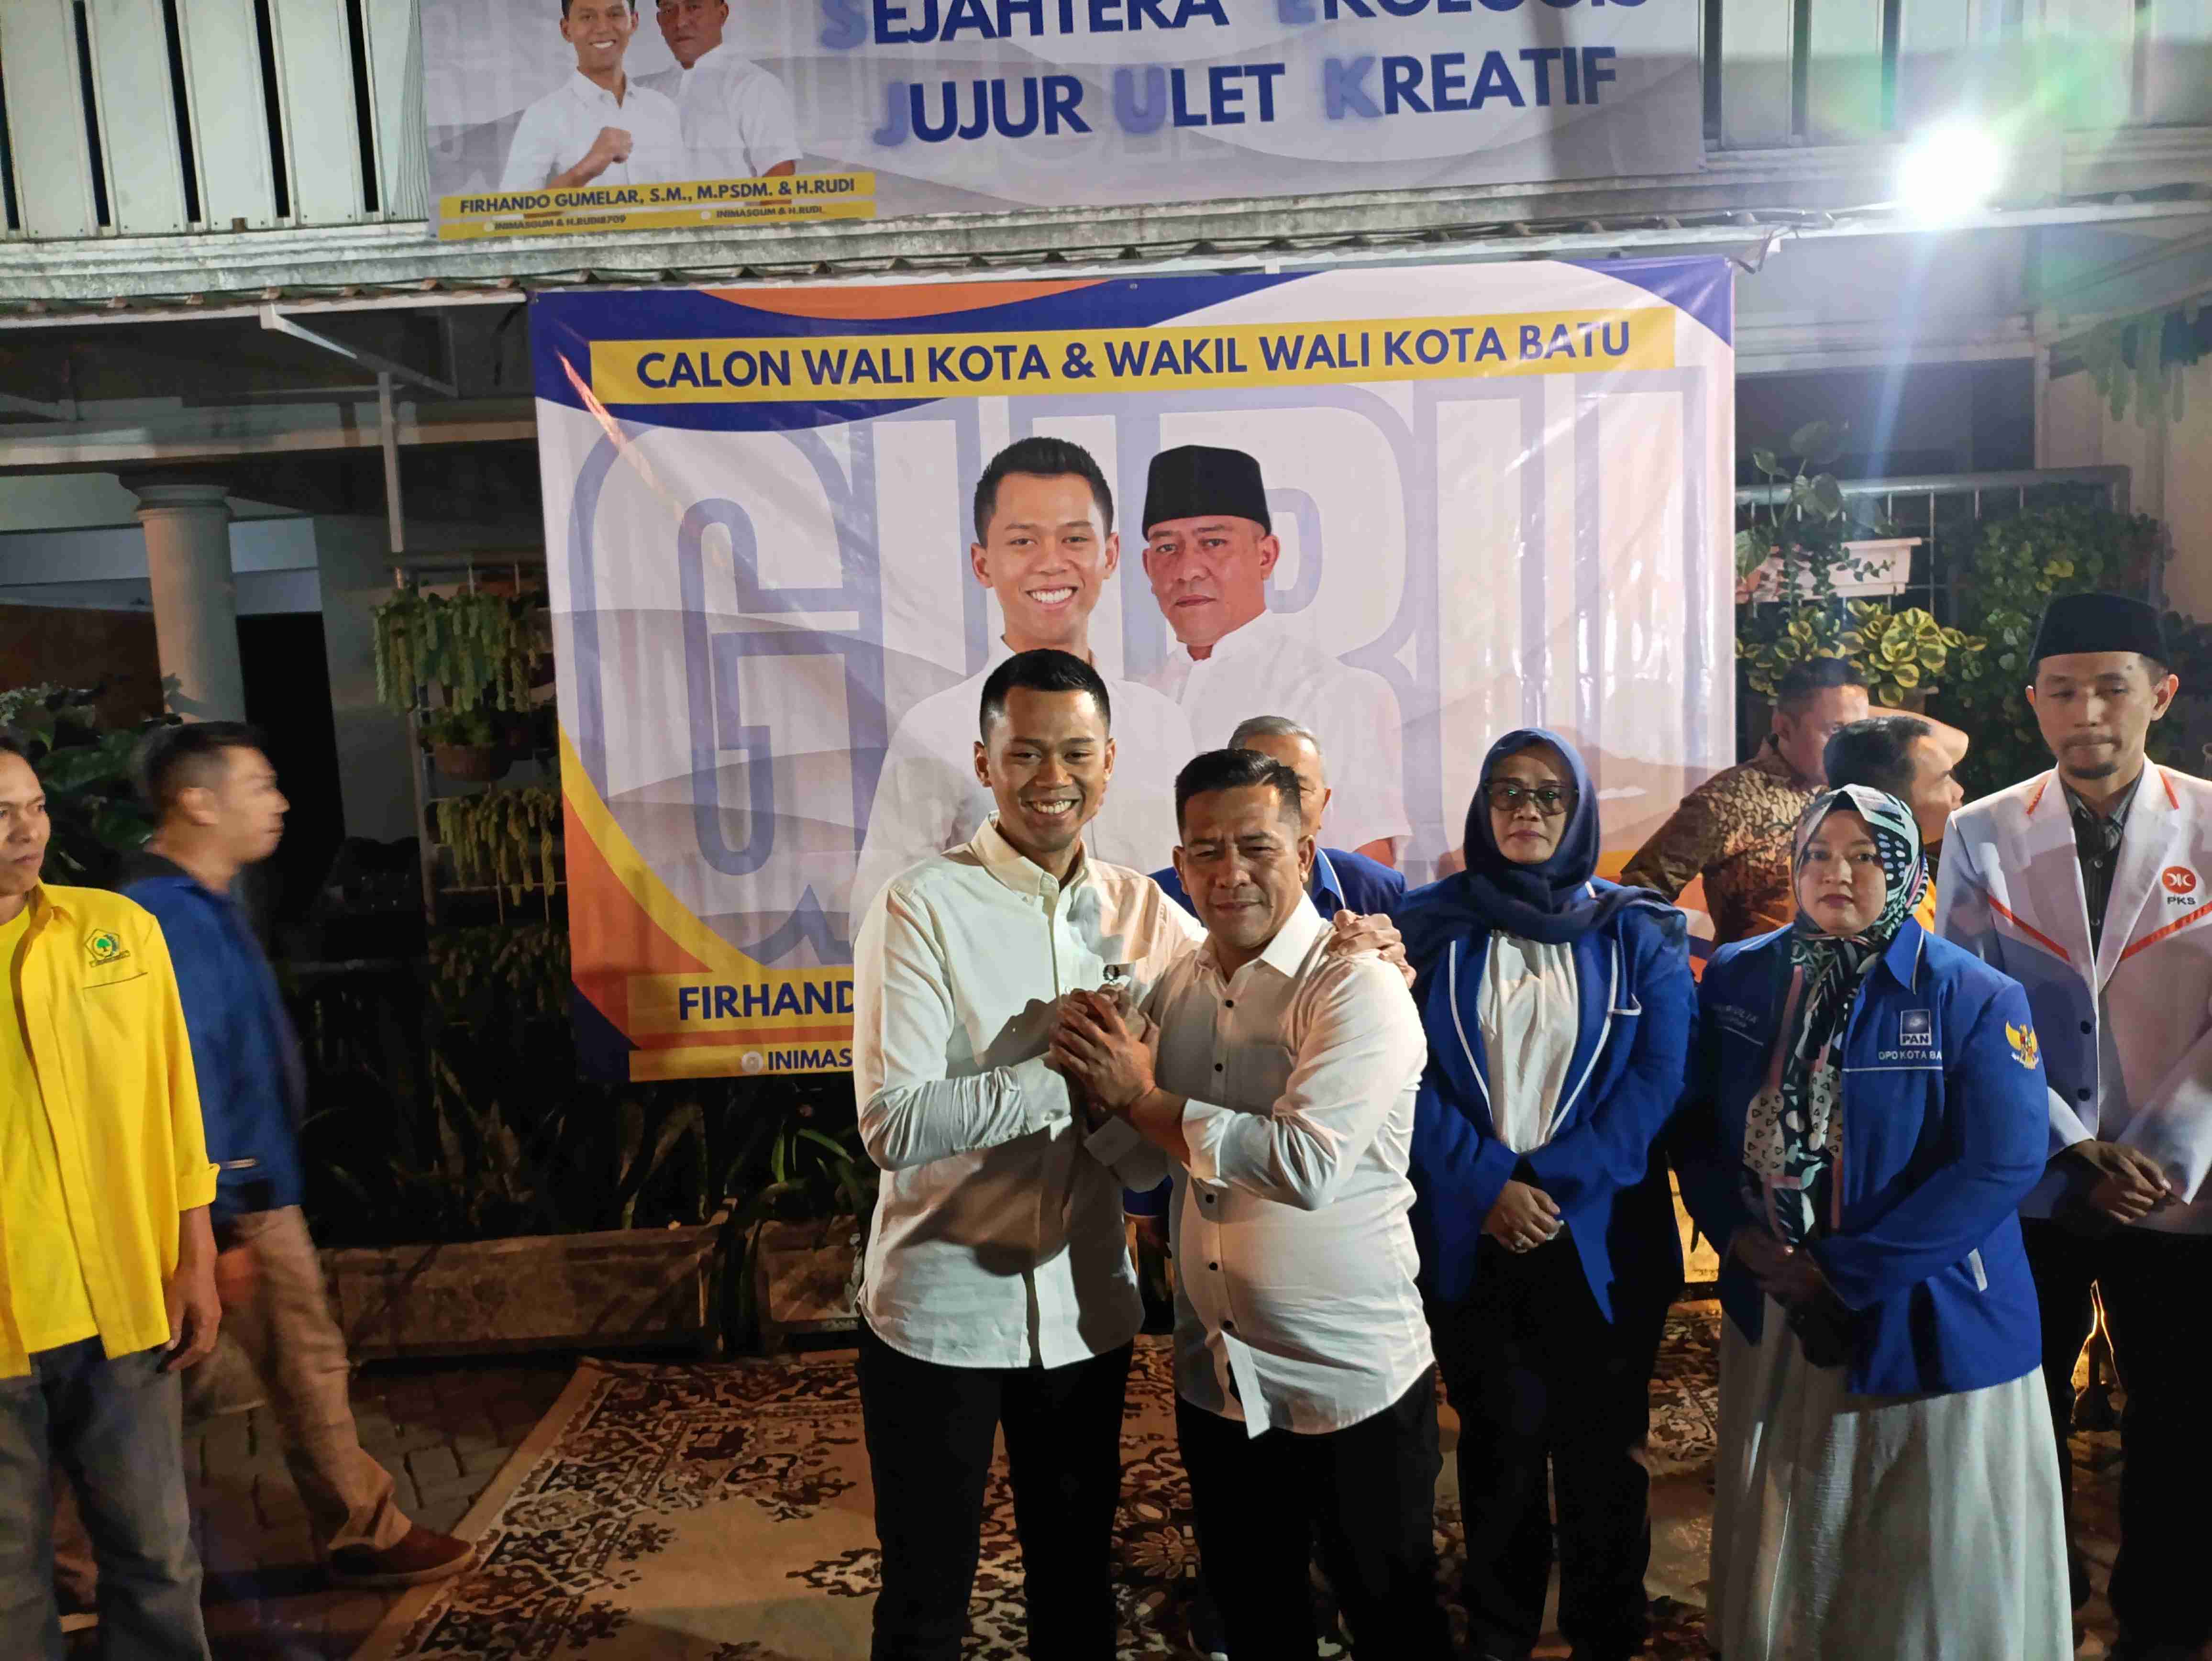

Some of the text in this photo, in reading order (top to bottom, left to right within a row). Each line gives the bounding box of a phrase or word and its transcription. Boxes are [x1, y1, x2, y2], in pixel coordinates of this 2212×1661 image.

[872, 47, 1616, 146] JUJUR ULET KREATIF
[460, 194, 551, 213] FIRHANDO
[554, 189, 644, 207] GUMELAR,
[697, 183, 773, 199] M.PSDM.
[778, 182, 792, 195] &
[796, 178, 855, 194] H.RUDI
[637, 321, 1629, 388] CALON WALI KOTA & WAKIL WALI KOTA BATU
[2167, 896, 2196, 905] PKS
[1902, 1034, 1929, 1044] PAN
[768, 1048, 853, 1071] INIMAS
[1900, 1050, 1927, 1060] KOTA
